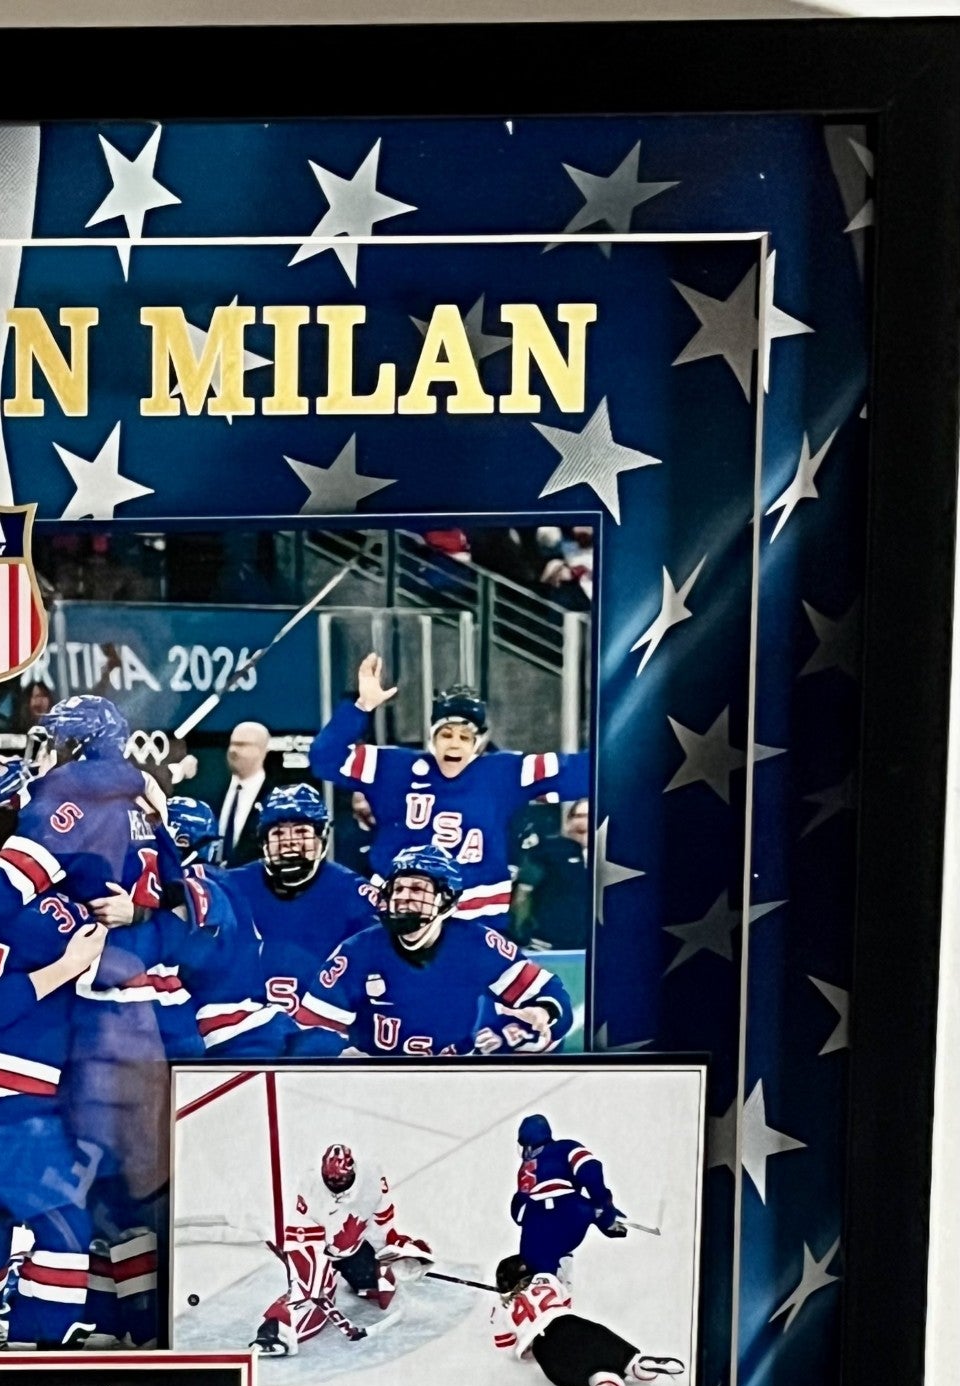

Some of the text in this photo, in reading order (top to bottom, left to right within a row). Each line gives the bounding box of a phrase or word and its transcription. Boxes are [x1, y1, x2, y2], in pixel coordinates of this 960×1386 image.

[140, 303, 597, 416] MILAN
[20, 641, 162, 691] RTINA
[406, 793, 484, 864] USA
[511, 1285, 560, 1327] 42
